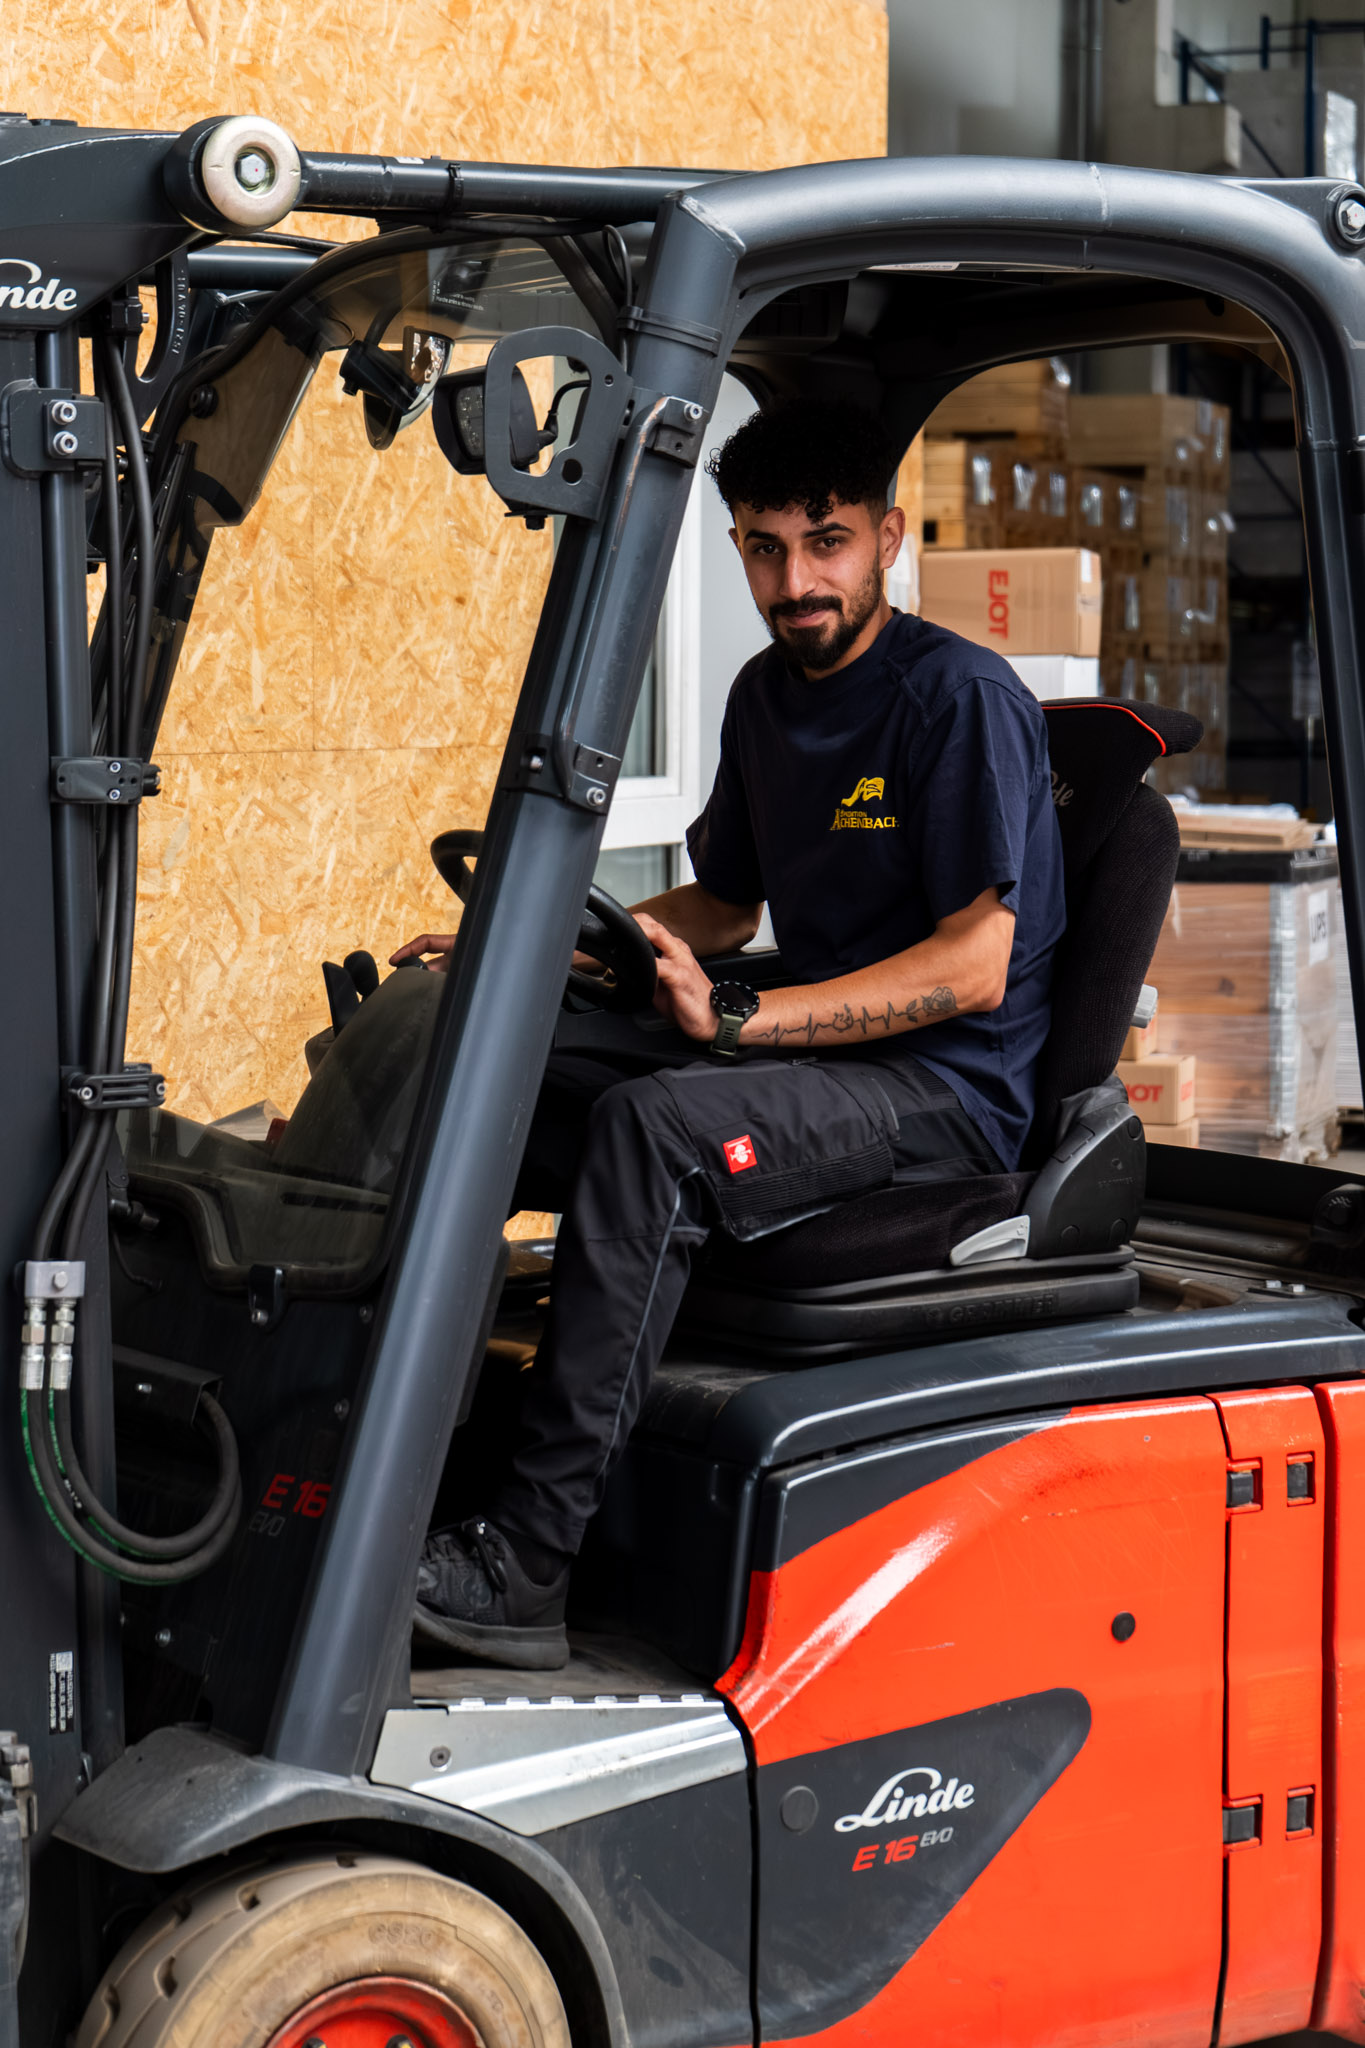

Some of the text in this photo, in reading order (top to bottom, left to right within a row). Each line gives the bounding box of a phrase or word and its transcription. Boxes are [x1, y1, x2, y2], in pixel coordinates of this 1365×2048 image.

[0, 258, 77, 311] nde
[988, 570, 1009, 640] EJOT
[261, 1473, 332, 1518] E 16
[248, 1511, 286, 1537] EVO
[834, 1767, 975, 1832] Linde
[851, 1826, 954, 1872] E 16 EVO
